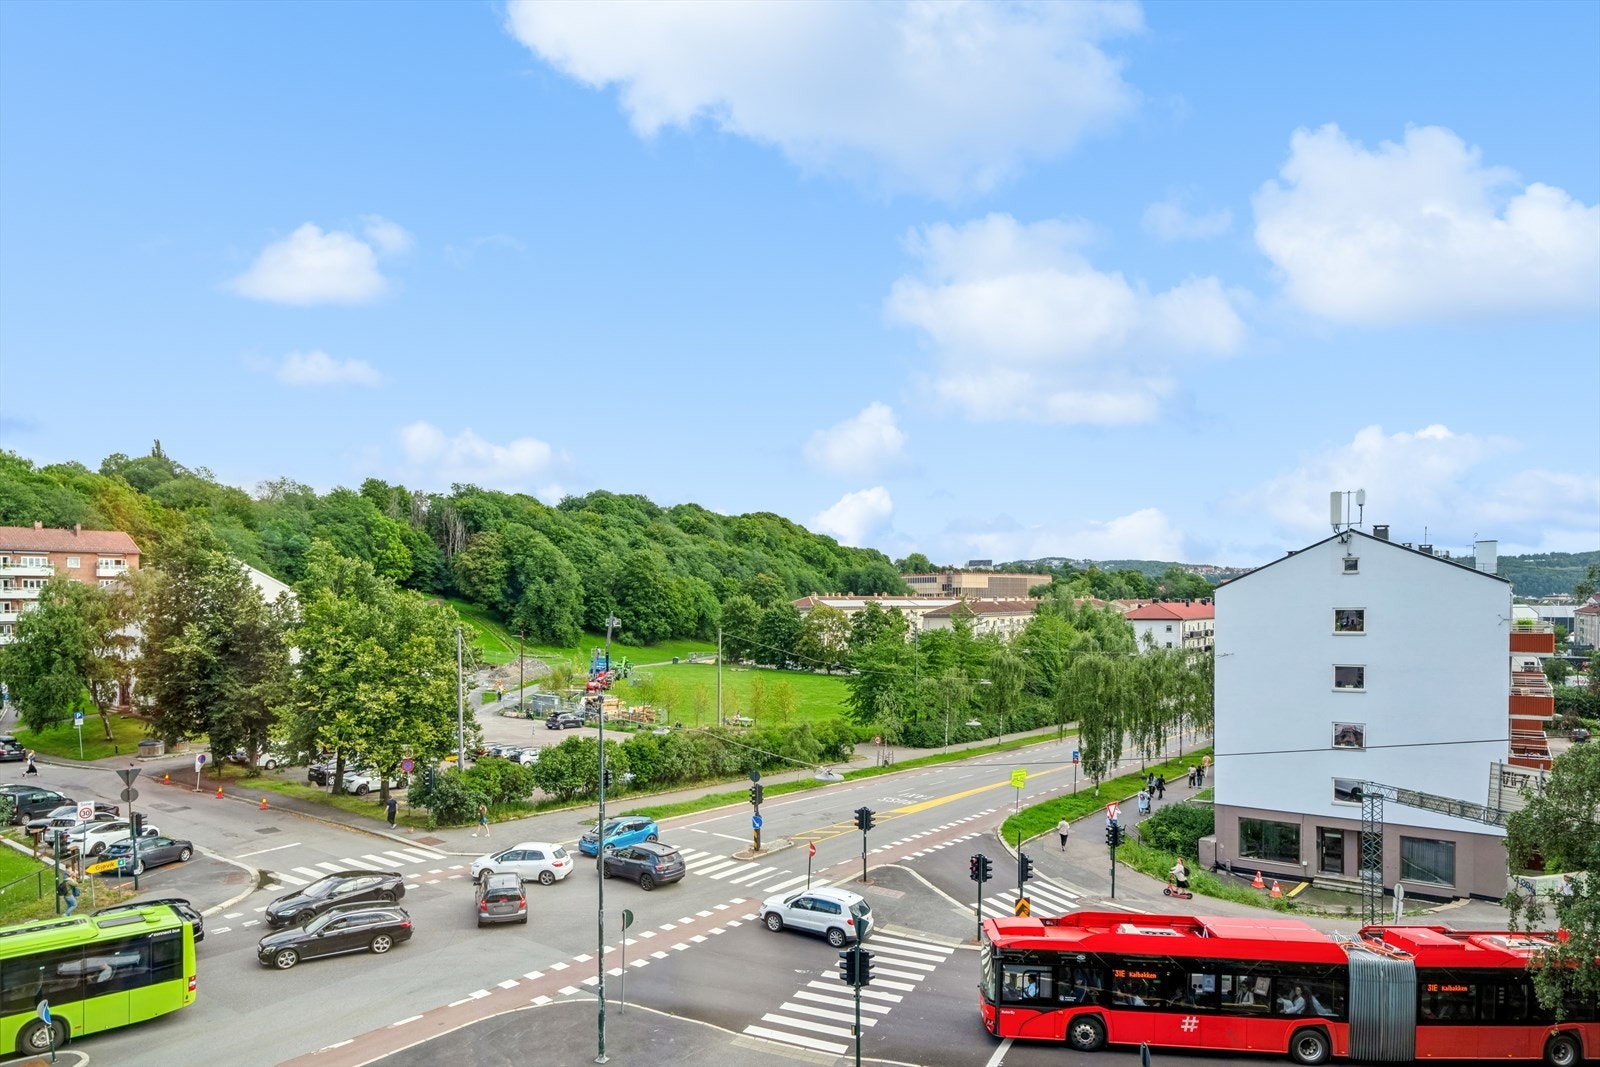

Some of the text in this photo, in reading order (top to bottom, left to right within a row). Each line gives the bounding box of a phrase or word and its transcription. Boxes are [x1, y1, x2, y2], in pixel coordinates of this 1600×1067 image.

[95, 862, 115, 870] Gjøvik
[1114, 969, 1157, 979] 31E Kalbakken
[1427, 984, 1438, 992] 31E
